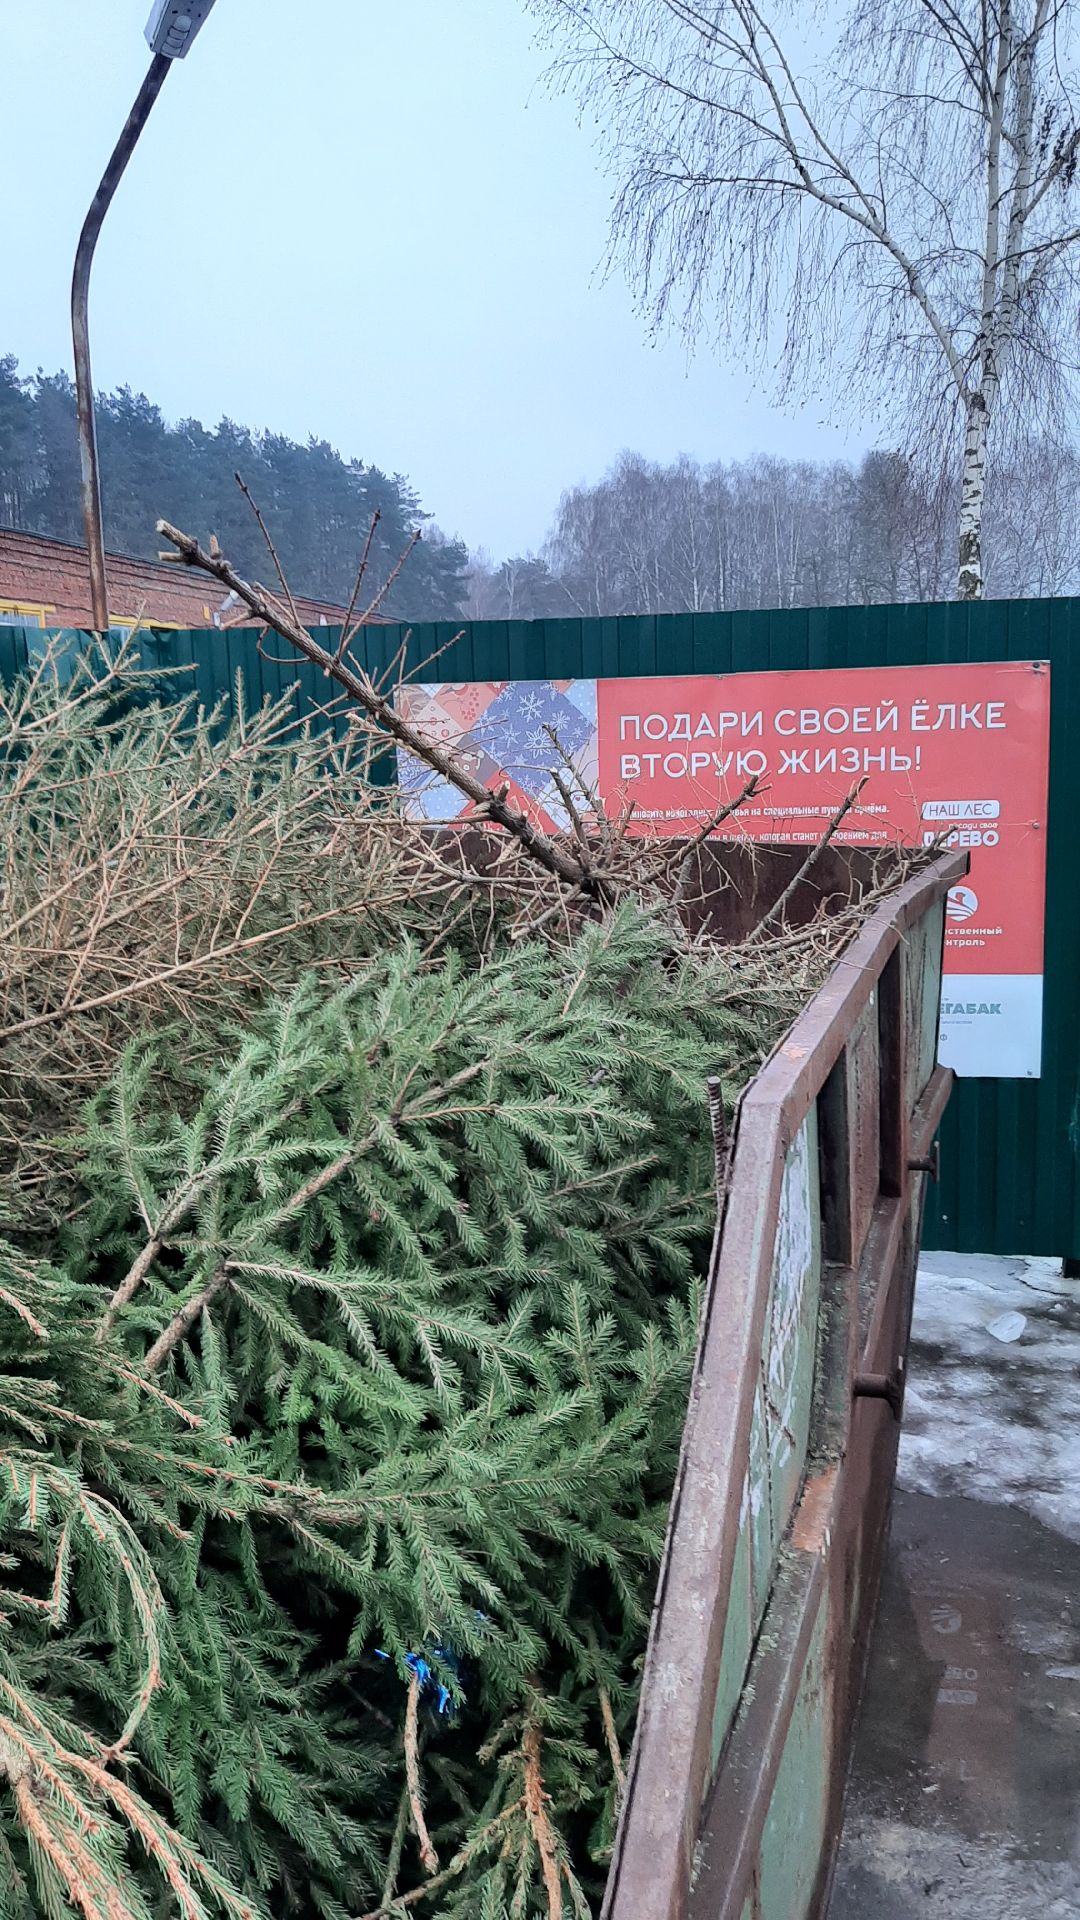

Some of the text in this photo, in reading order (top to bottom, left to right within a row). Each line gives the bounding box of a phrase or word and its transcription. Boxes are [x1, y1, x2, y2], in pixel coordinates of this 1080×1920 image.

[620, 699, 1006, 742] ПОДАРИ СВОЕЙ ЁЛКЕ
[620, 745, 921, 779] ВТОРУЮ ЖИЗНЬ!
[929, 803, 993, 817] НАШ ЛЕС
